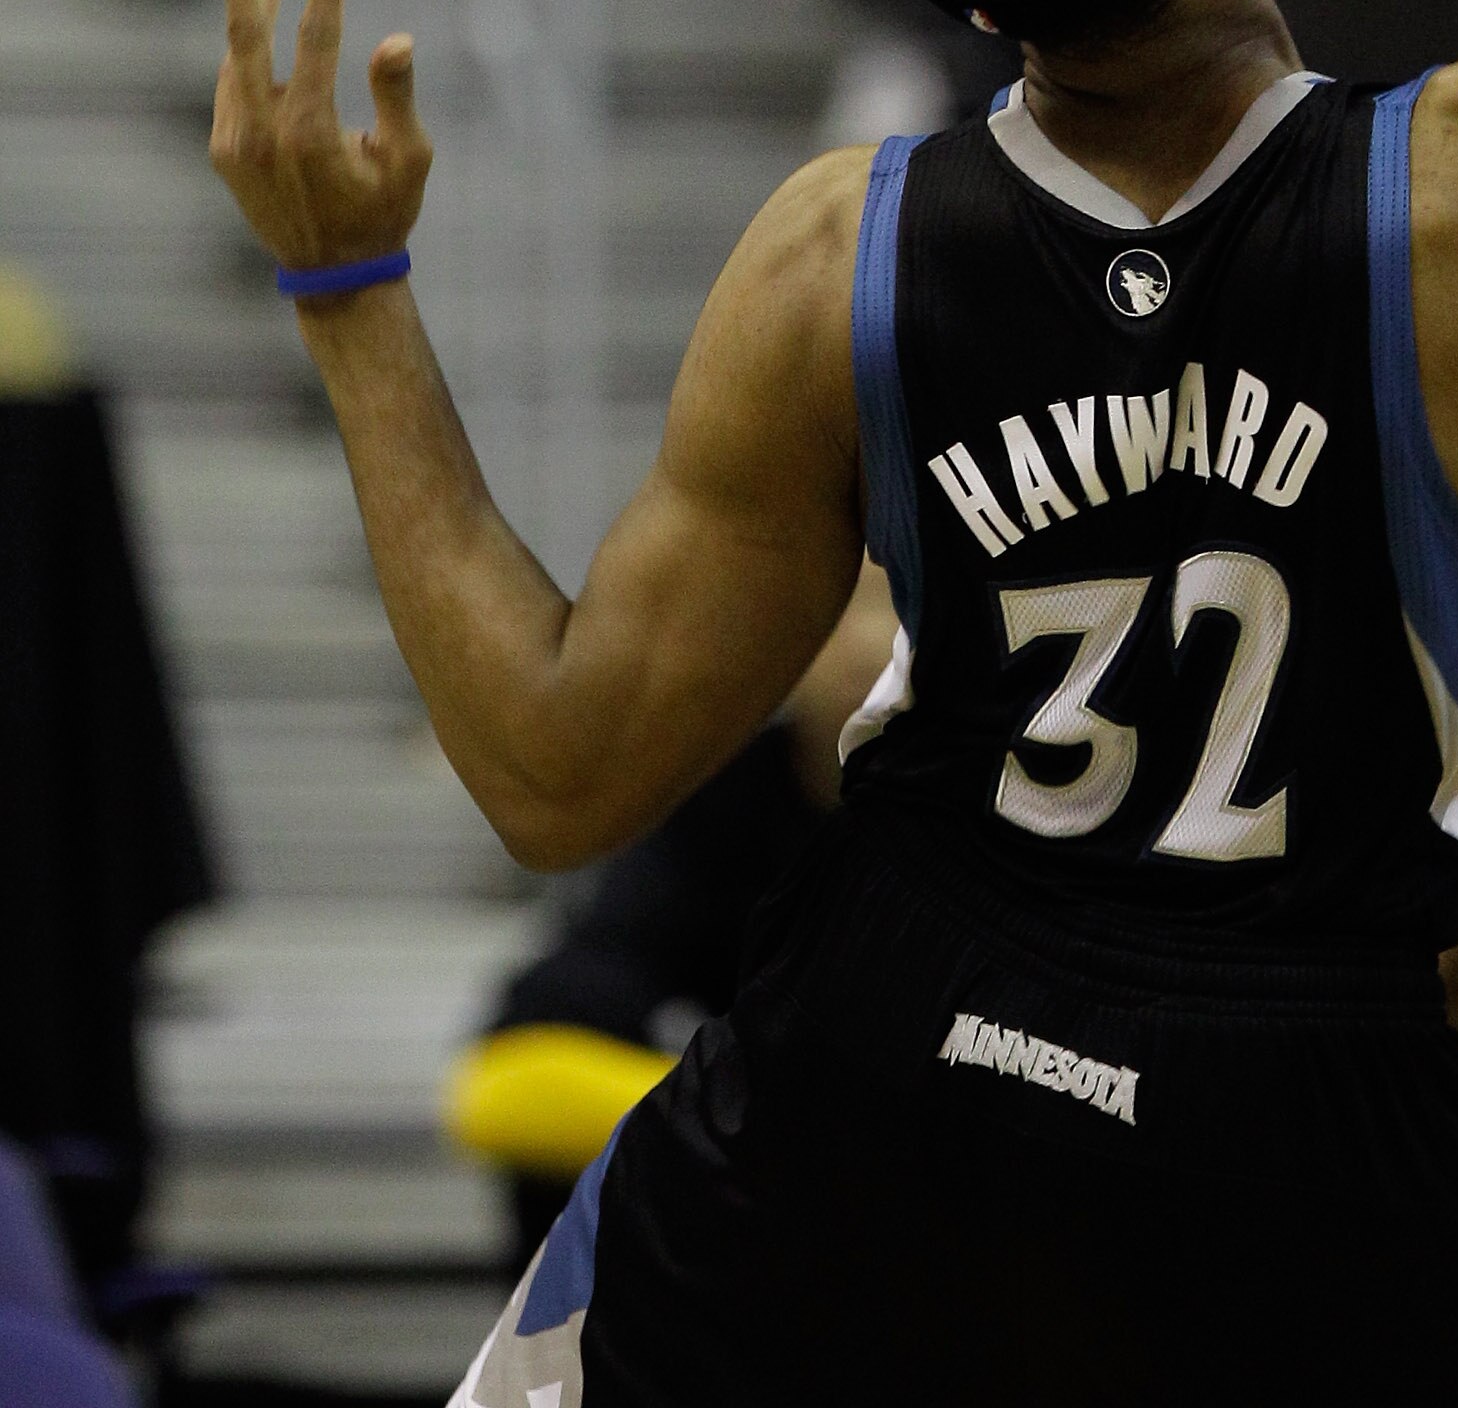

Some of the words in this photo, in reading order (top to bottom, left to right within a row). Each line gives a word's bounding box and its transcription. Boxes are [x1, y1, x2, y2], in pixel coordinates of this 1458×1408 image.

[928, 362, 1328, 557] HAYWARD
[995, 550, 1293, 862] 32
[937, 1012, 1140, 1126] MINNESOTA
